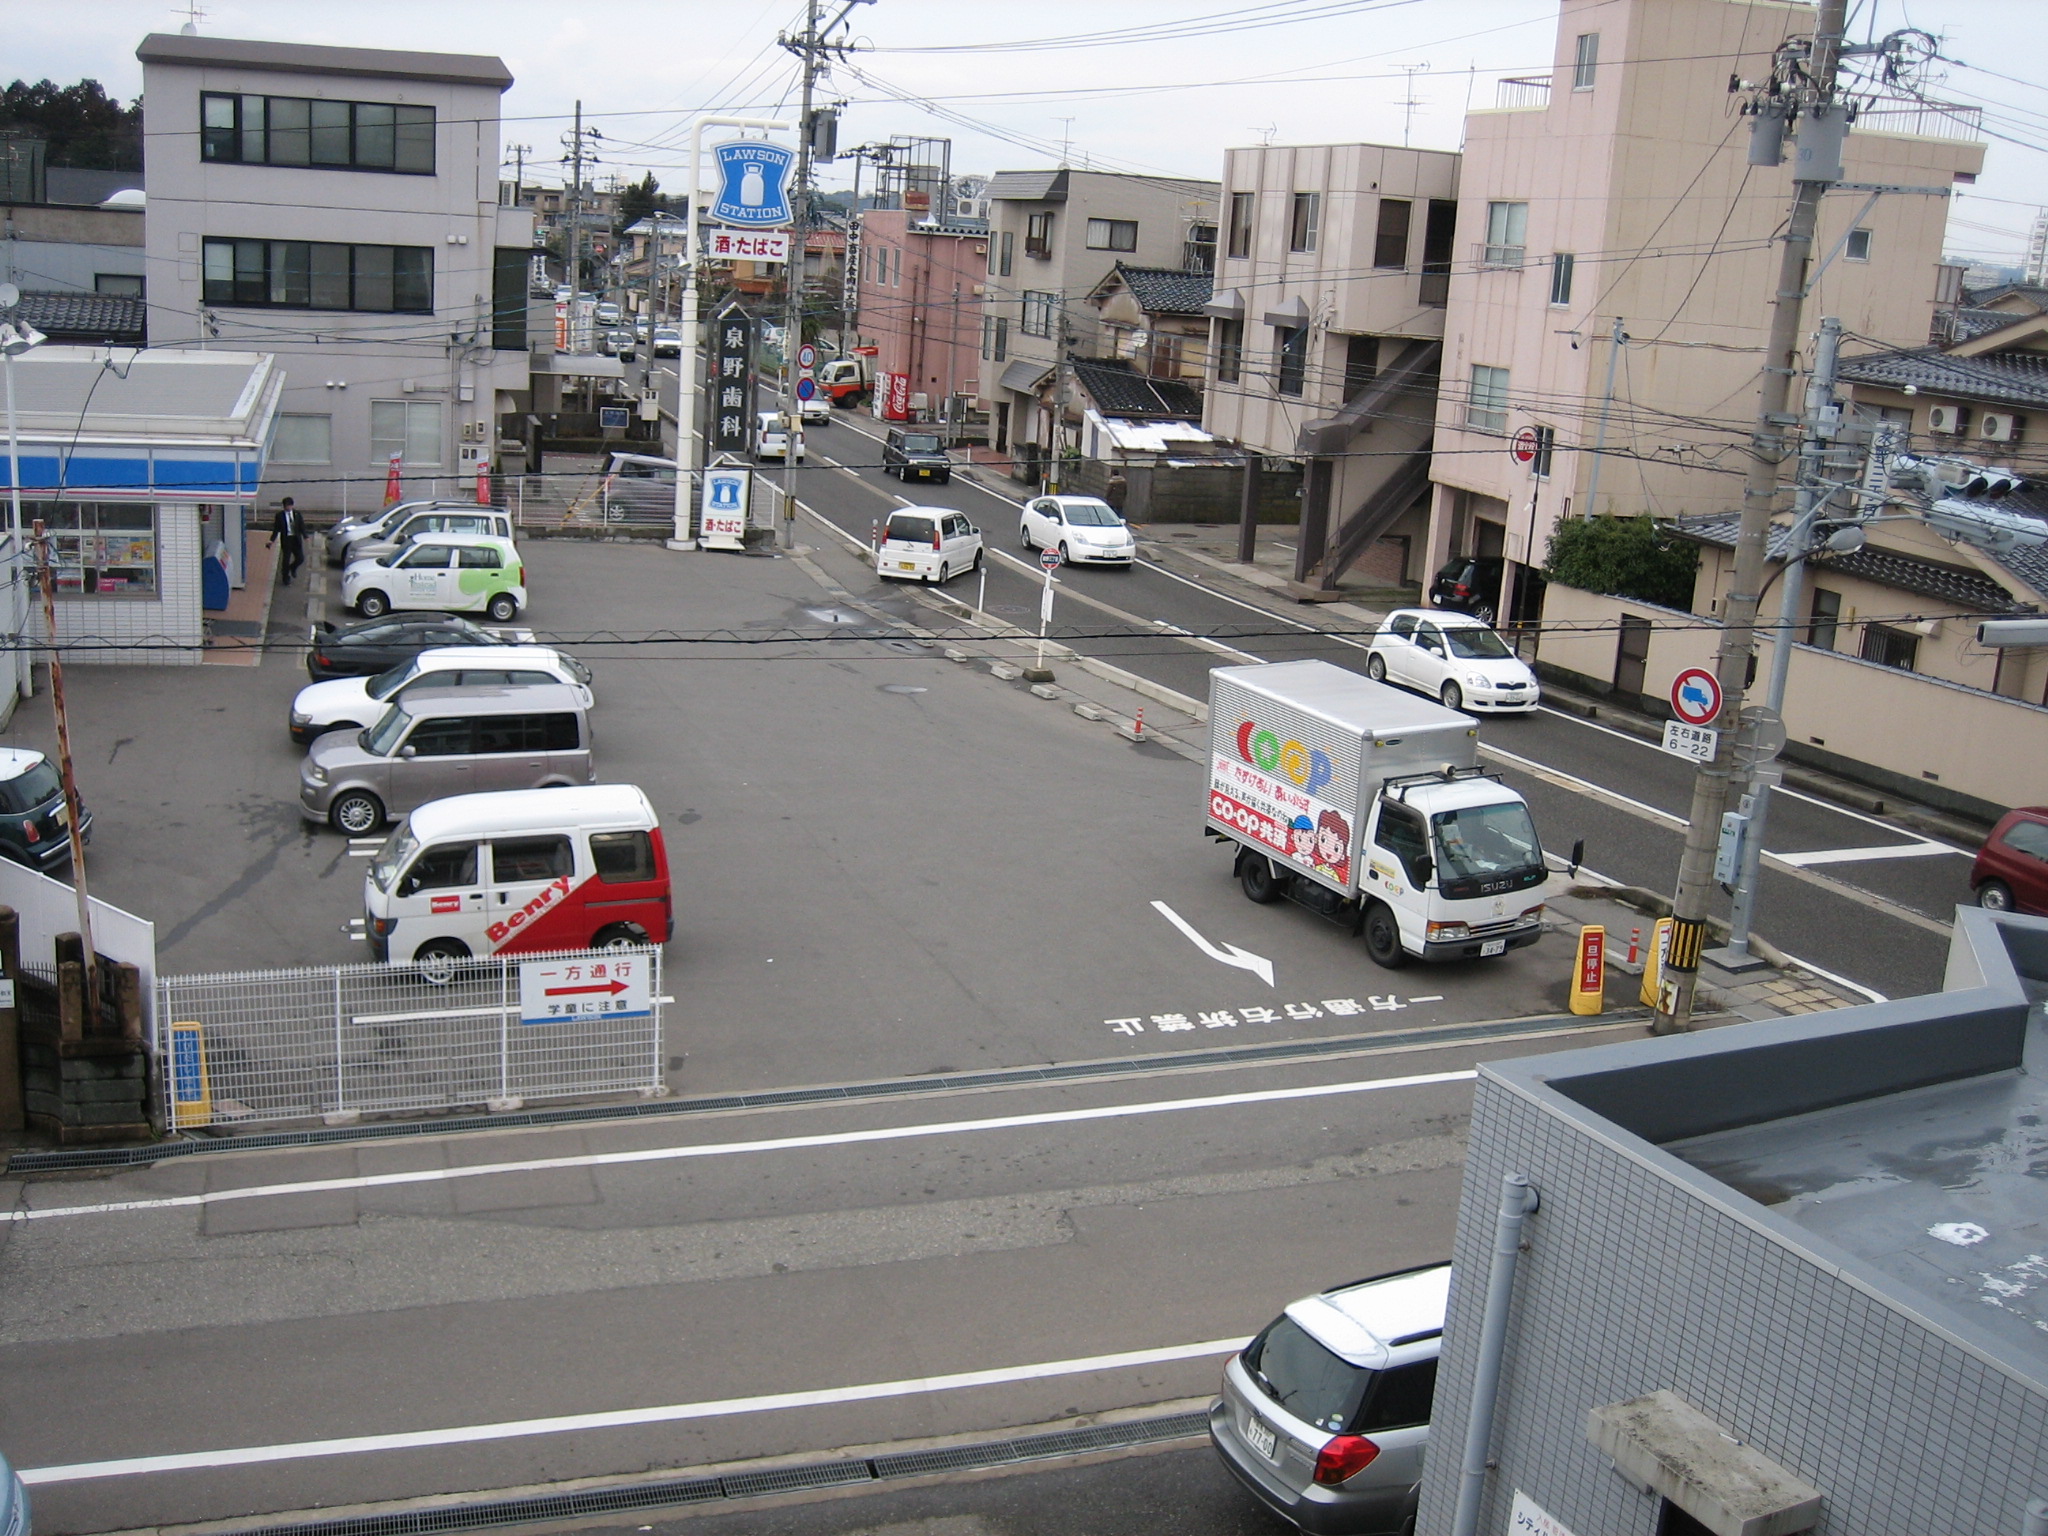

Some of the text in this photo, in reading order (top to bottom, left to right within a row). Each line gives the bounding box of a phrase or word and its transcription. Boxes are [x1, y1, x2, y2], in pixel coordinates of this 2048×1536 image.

[722, 149, 786, 166] LAWSON
[720, 203, 783, 219] STATION
[802, 351, 812, 362] 40
[721, 326, 744, 437] 泉野歯科
[1670, 725, 1712, 744] 左右道路
[1481, 879, 1514, 892] ISUZU
[484, 874, 571, 943] Benry
[1586, 936, 1600, 983] 一旦停止
[540, 961, 632, 980] 一方通行
[548, 999, 628, 1015] 学童に注意
